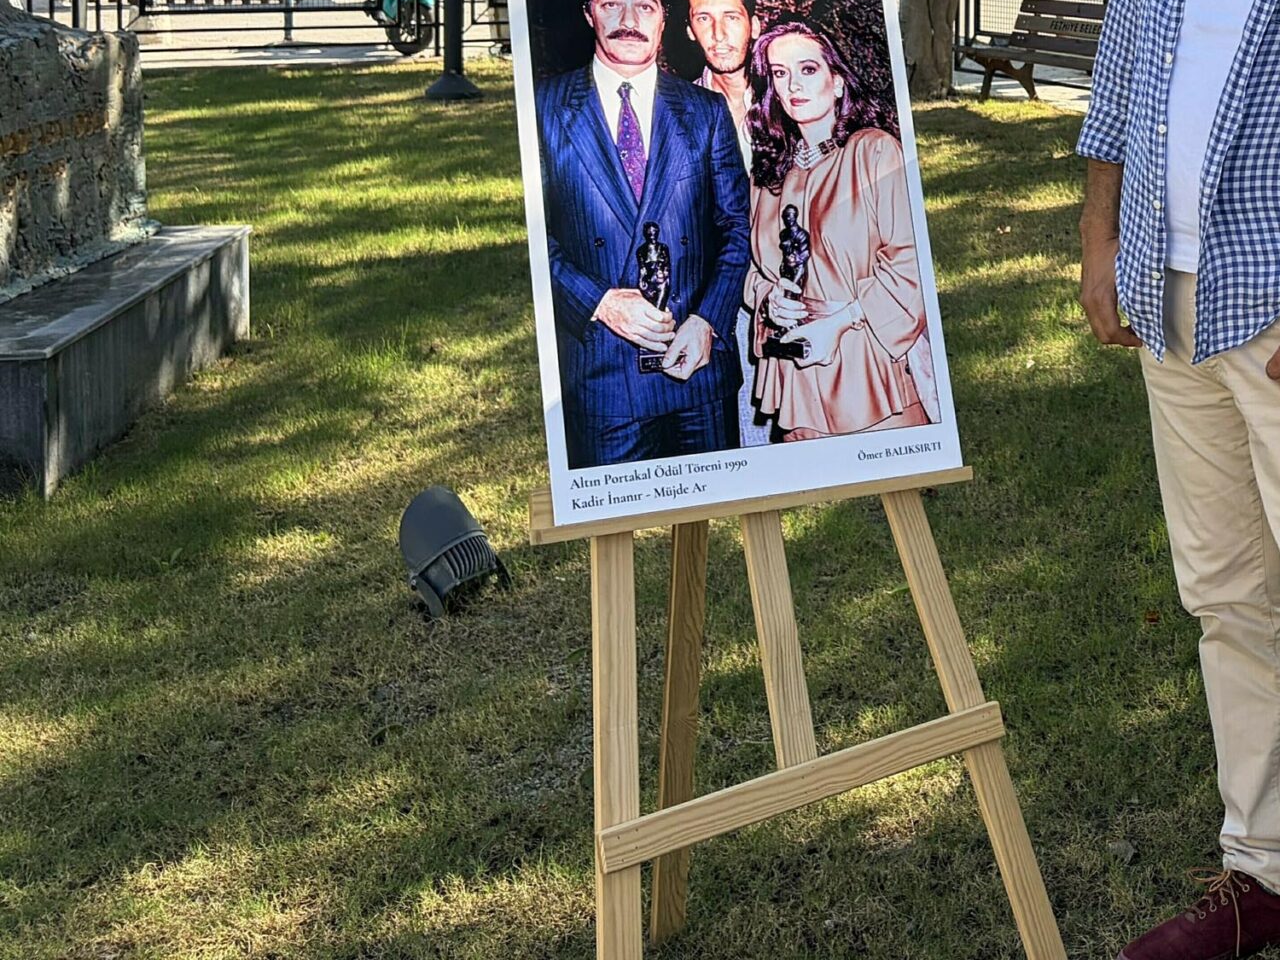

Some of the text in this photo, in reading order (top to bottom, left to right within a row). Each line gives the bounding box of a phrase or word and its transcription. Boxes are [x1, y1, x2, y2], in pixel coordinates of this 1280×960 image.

[858, 441, 942, 461] Ömer BALIKSIRTI
[570, 458, 748, 490] Altın Portakal Ödül Töreni 1990
[572, 493, 605, 511] Kadir
[607, 491, 644, 506] İnanır
[653, 482, 690, 500] Müjde
[692, 482, 708, 494] Ar
